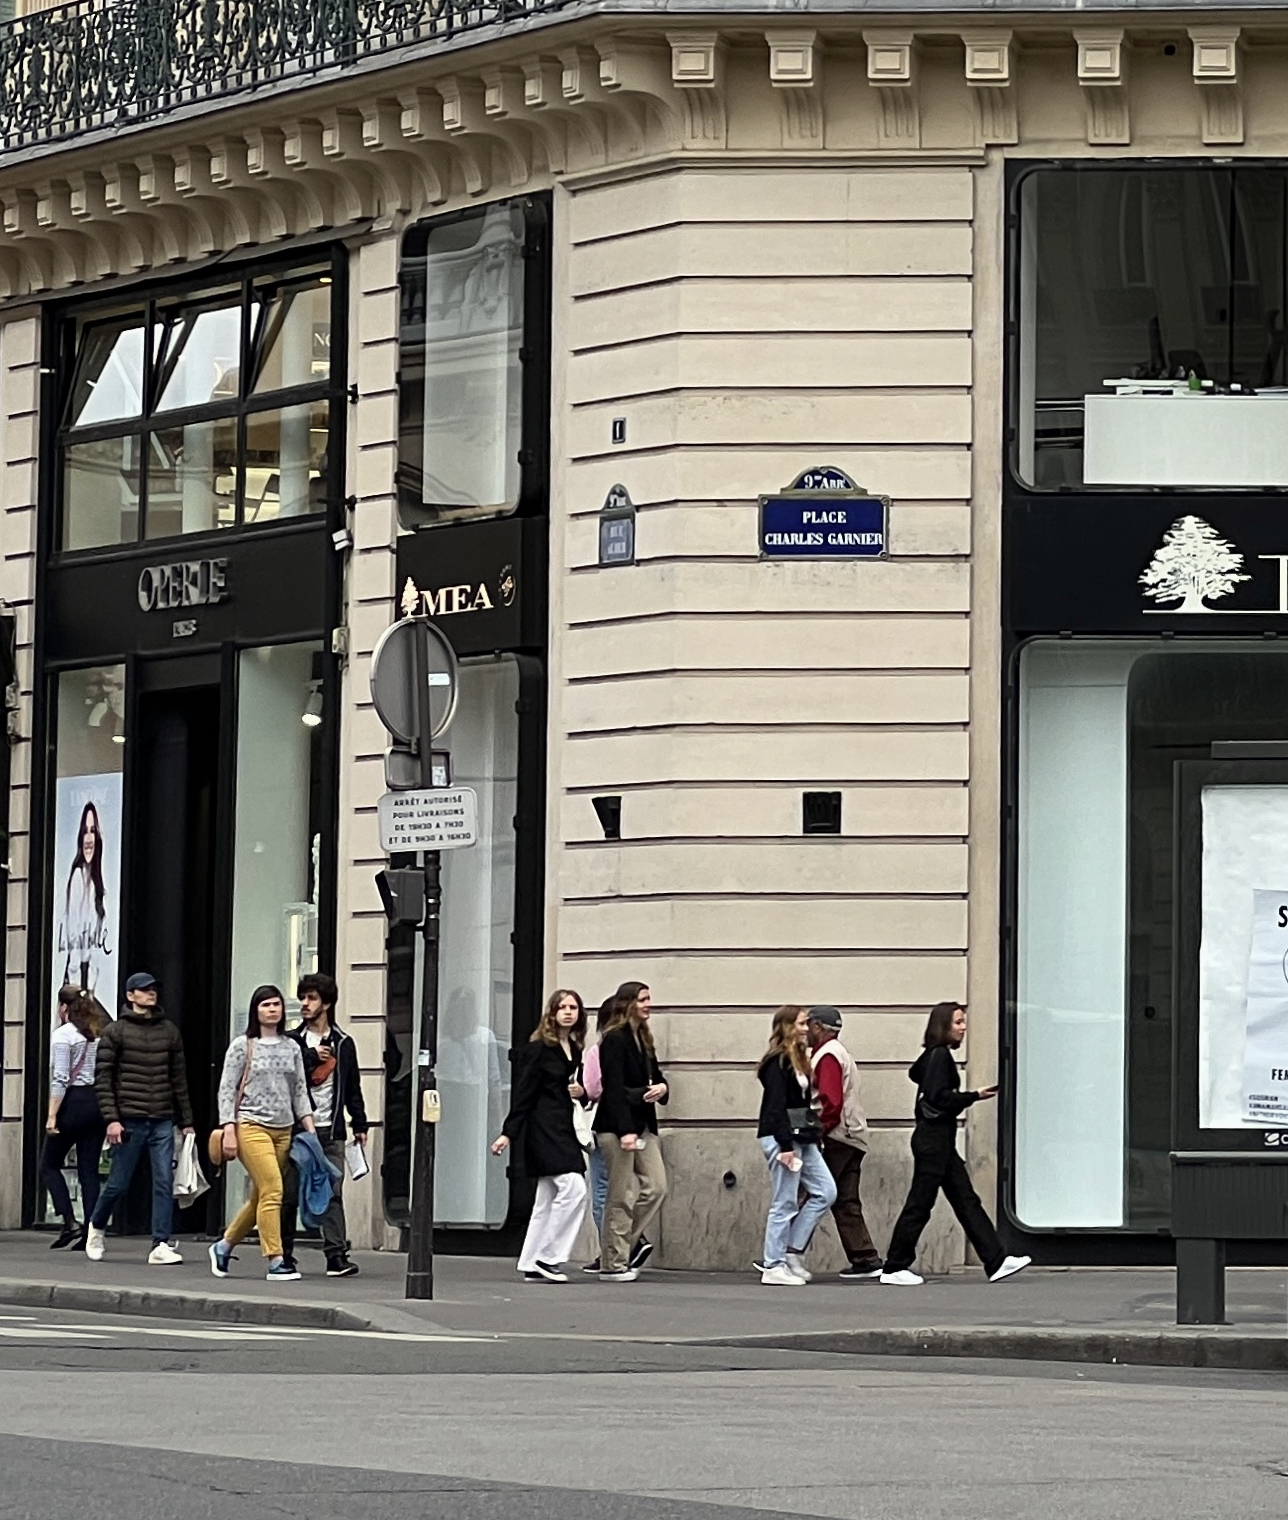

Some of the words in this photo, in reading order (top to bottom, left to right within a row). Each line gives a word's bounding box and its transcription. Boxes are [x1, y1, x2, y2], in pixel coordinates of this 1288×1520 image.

[802, 511, 847, 524] PLACE
[764, 533, 824, 545] CHARLES
[827, 533, 883, 545] GARNIER
[420, 582, 495, 616] MEA
[393, 811, 414, 819] POUR
[417, 808, 464, 818] LIVRAISONS
